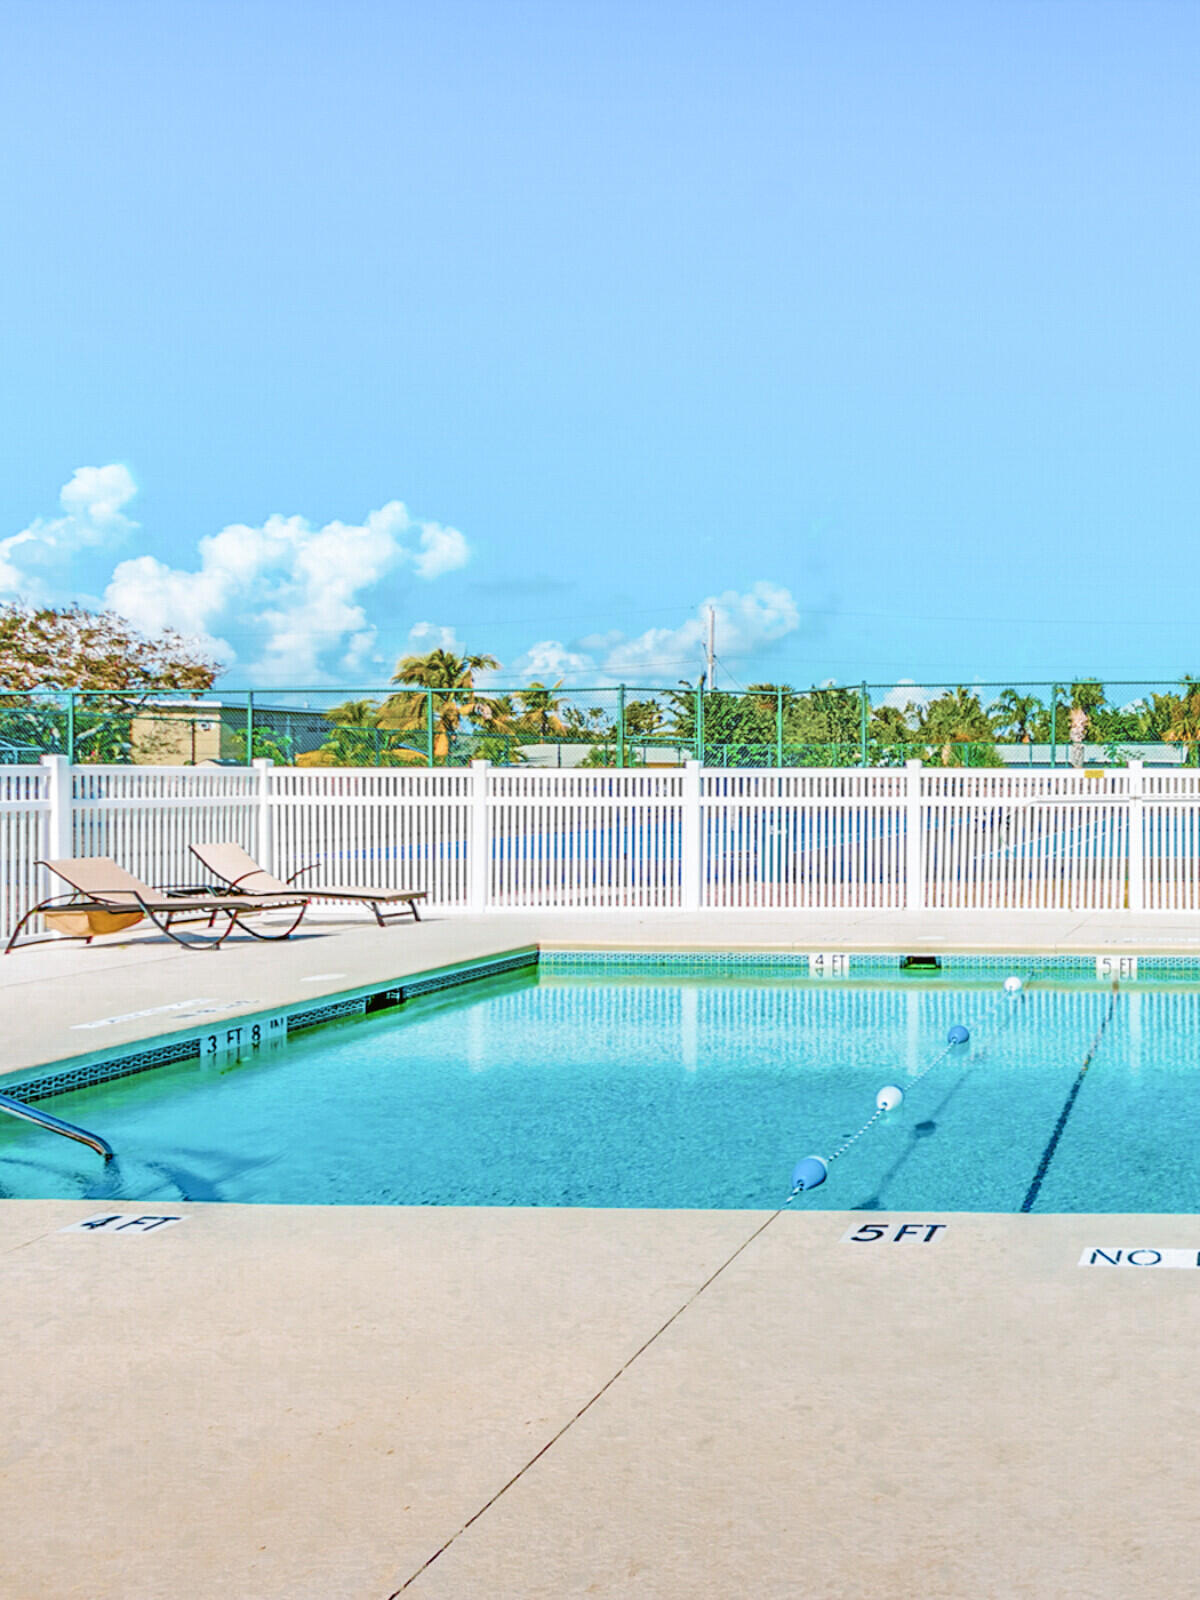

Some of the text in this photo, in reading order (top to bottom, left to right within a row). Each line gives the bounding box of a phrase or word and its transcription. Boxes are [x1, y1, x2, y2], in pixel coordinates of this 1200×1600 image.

[815, 954, 824, 967] 4
[1103, 957, 1112, 972] 5
[207, 1035, 217, 1055] 3
[227, 1027, 243, 1044] FT
[252, 1024, 261, 1041] 8
[80, 1215, 182, 1231] 4 FT
[851, 1224, 947, 1242] 5 FT
[1090, 1248, 1163, 1266] NO
